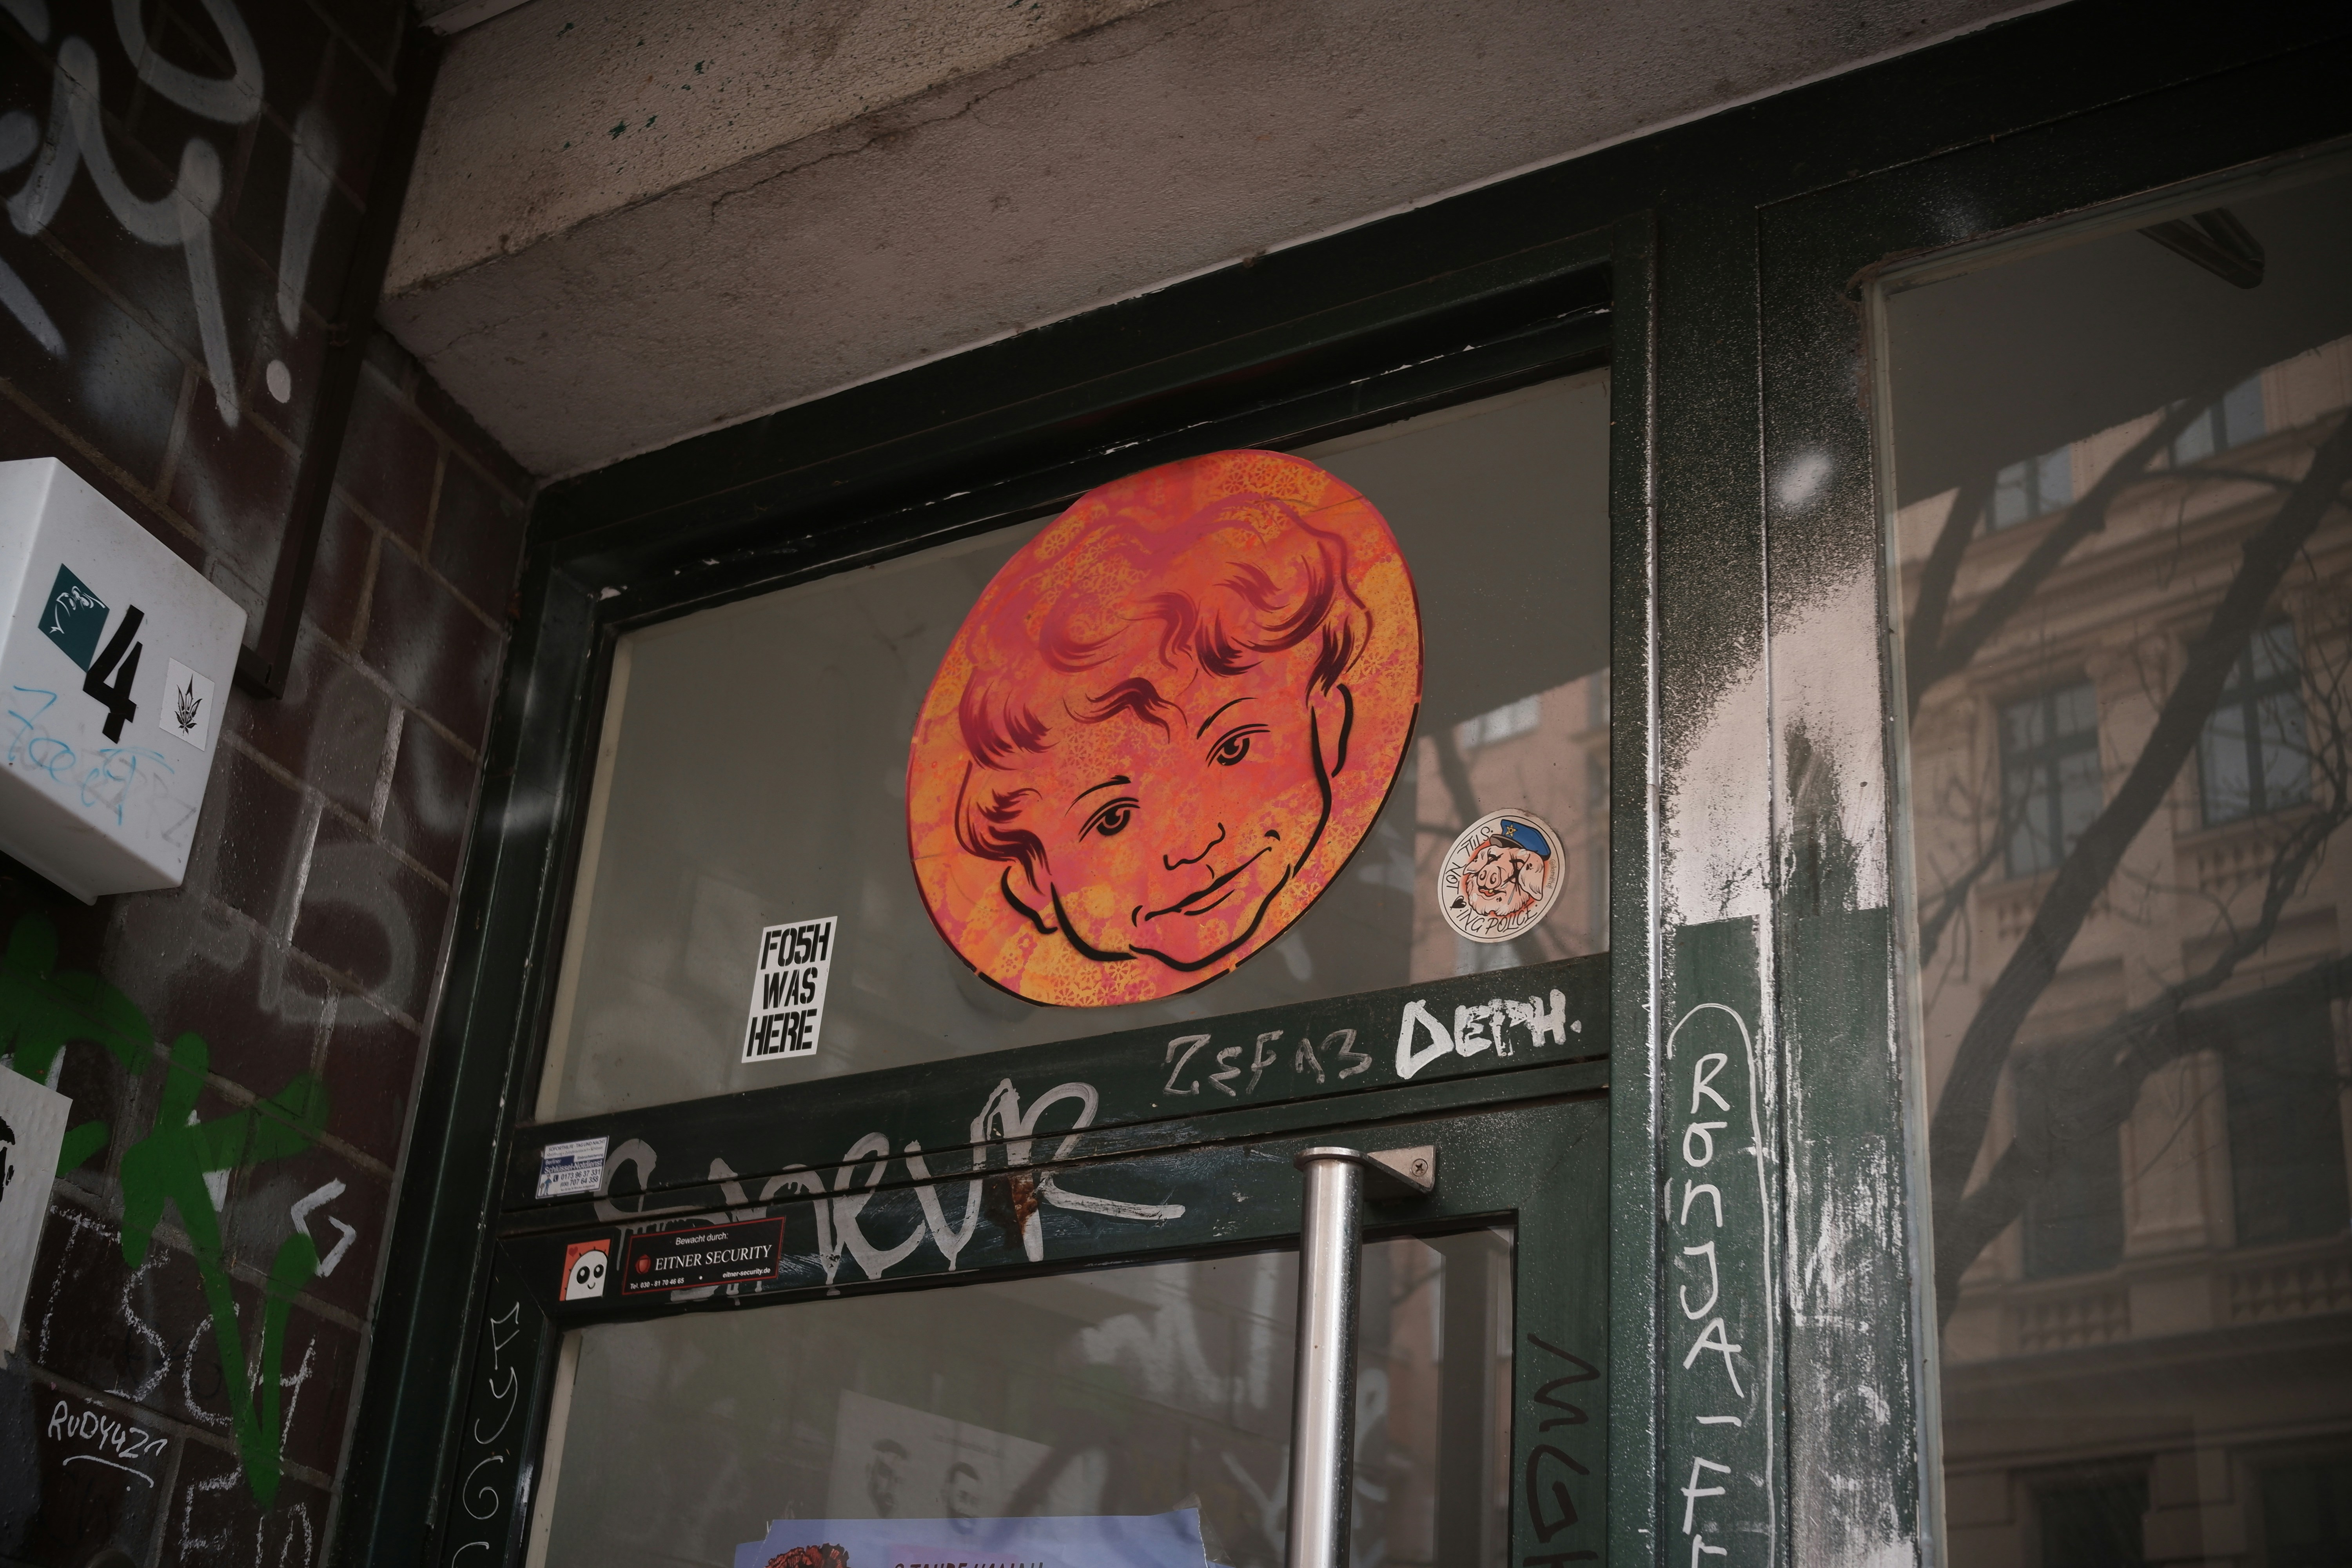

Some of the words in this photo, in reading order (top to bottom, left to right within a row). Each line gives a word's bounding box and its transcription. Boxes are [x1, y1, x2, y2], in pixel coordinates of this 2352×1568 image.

[83, 604, 144, 744] 4
[763, 967, 818, 1010] WAS
[746, 1008, 818, 1057] HERE
[544, 1160, 603, 1173] Schlüssel-Notdienst
[675, 1234, 705, 1245] Bewacht
[707, 1232, 729, 1241] durch:
[655, 1254, 702, 1271] EITNER
[706, 1245, 772, 1265] SECURITY
[722, 1267, 770, 1278] eitner-security.de
